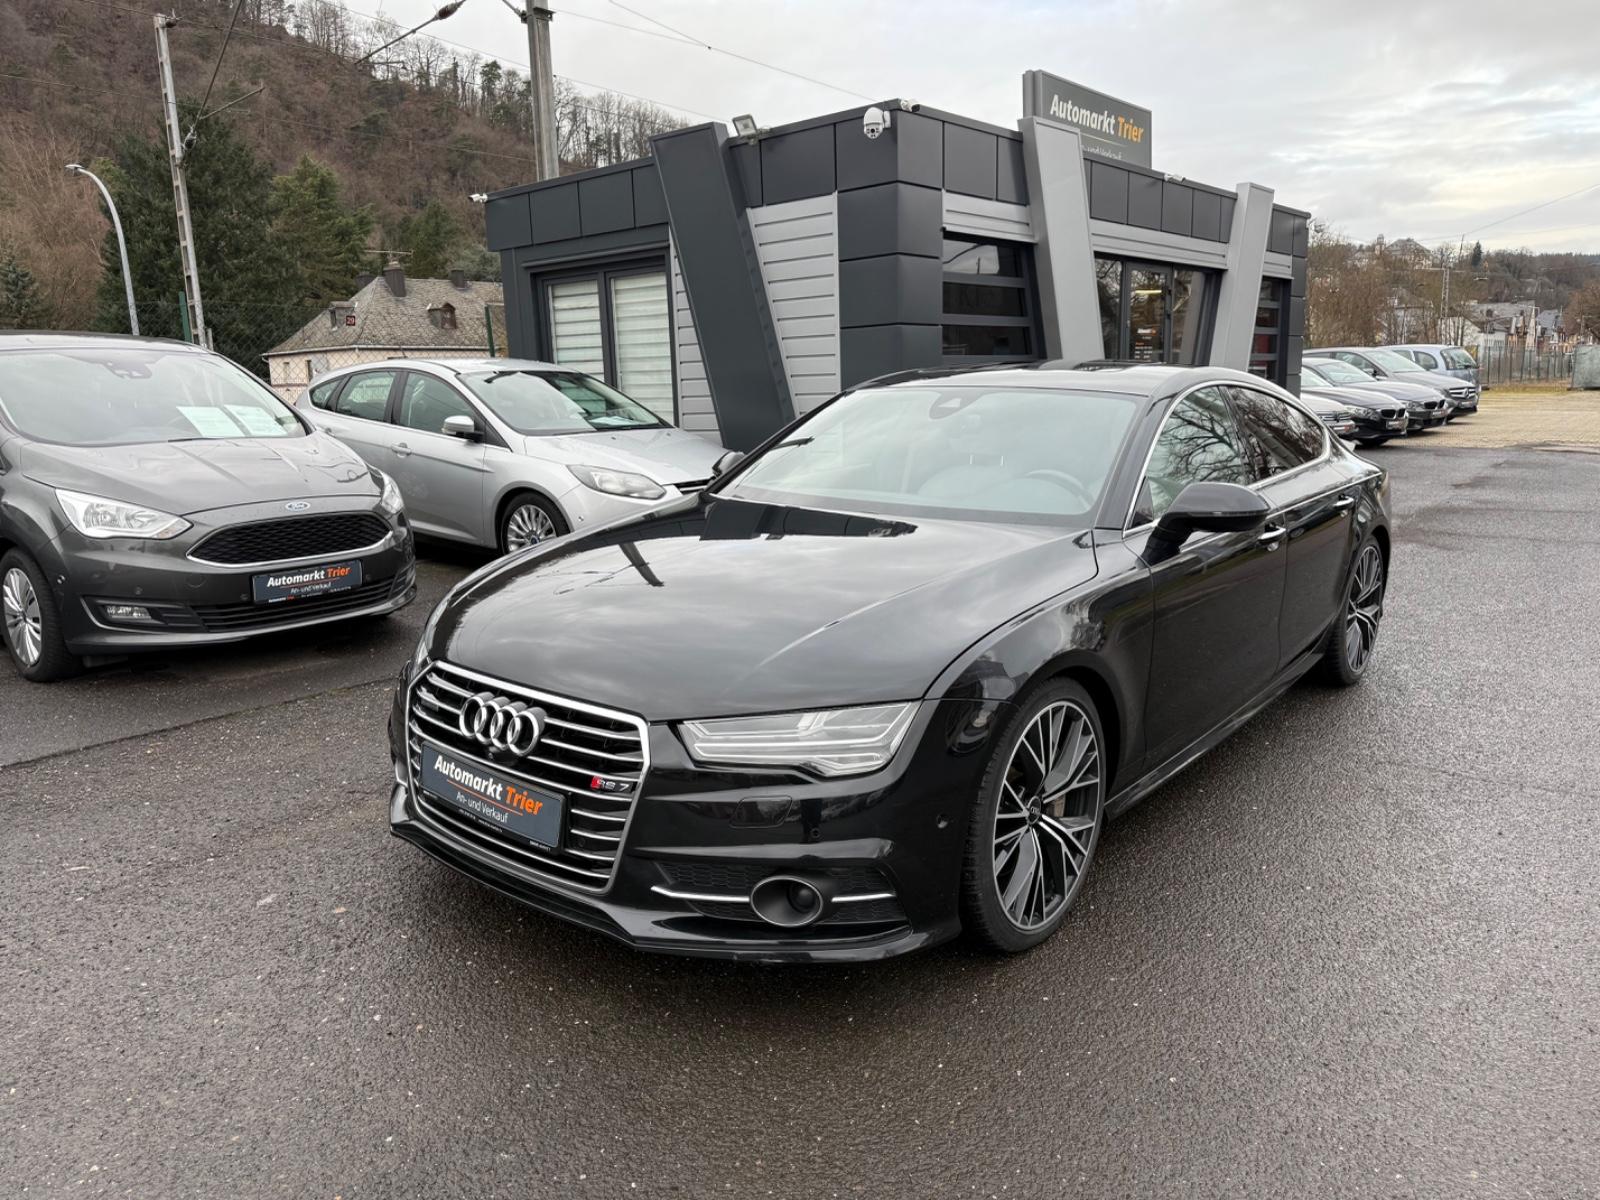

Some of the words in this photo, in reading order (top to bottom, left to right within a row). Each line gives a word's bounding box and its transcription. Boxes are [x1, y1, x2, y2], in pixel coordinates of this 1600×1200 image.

[1050, 94, 1116, 135] Automarkt
[1118, 115, 1144, 142] Trier
[267, 570, 325, 587] Automarkt
[327, 567, 352, 577] Trier
[434, 754, 503, 800] Automarkt
[505, 785, 543, 815] Trier
[456, 791, 467, 803] An-
[467, 798, 481, 811] und
[481, 800, 509, 823] Verkauf
